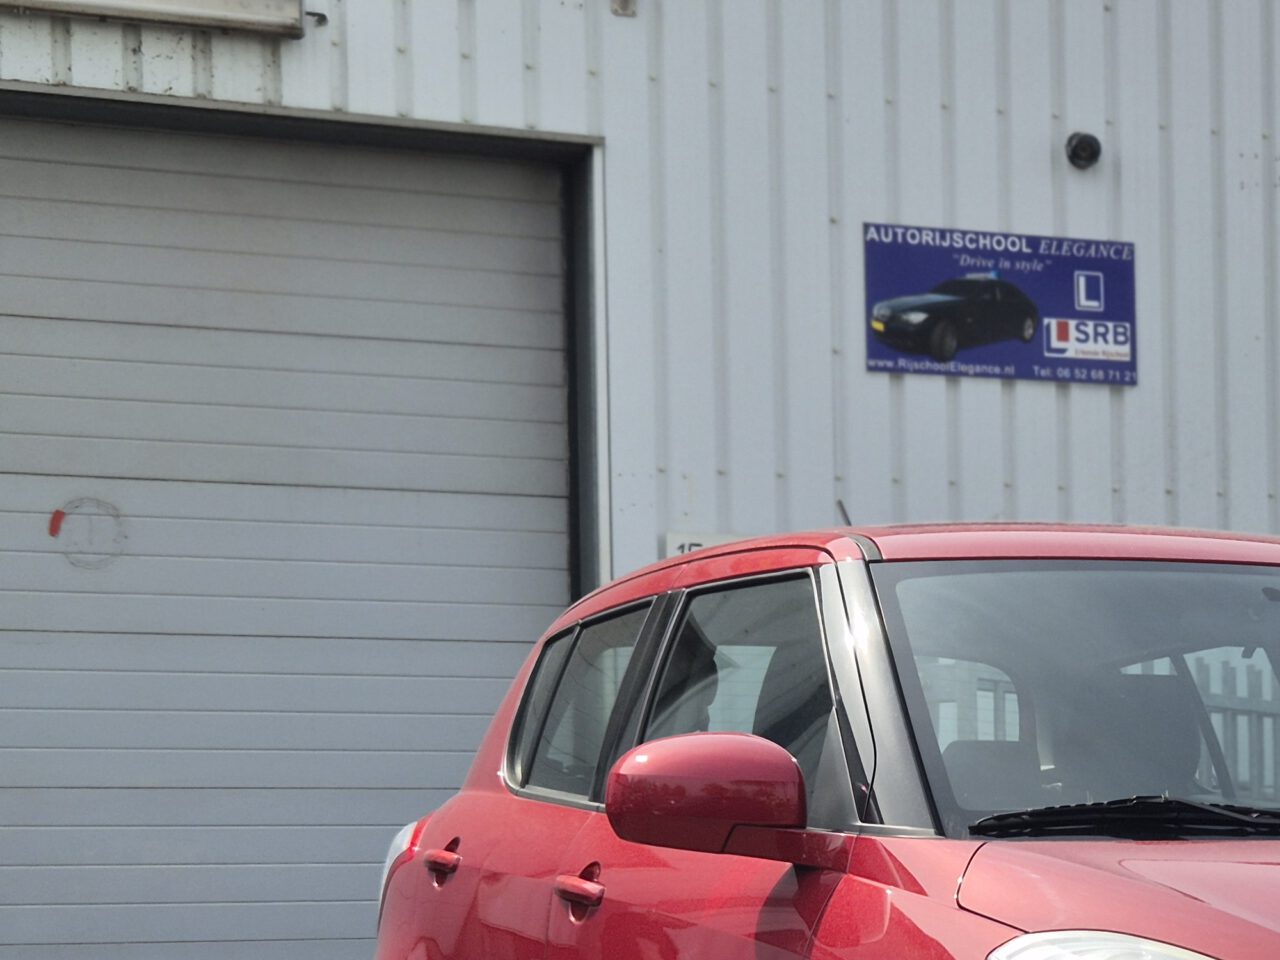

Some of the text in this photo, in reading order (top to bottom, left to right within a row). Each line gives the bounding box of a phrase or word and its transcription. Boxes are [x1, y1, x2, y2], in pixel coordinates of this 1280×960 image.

[866, 226, 1133, 260] AUTORIJSCHOOL ELEGANCE
[999, 256, 1011, 270] in
[1075, 321, 1130, 346] SRB
[1056, 366, 1071, 379] 06
